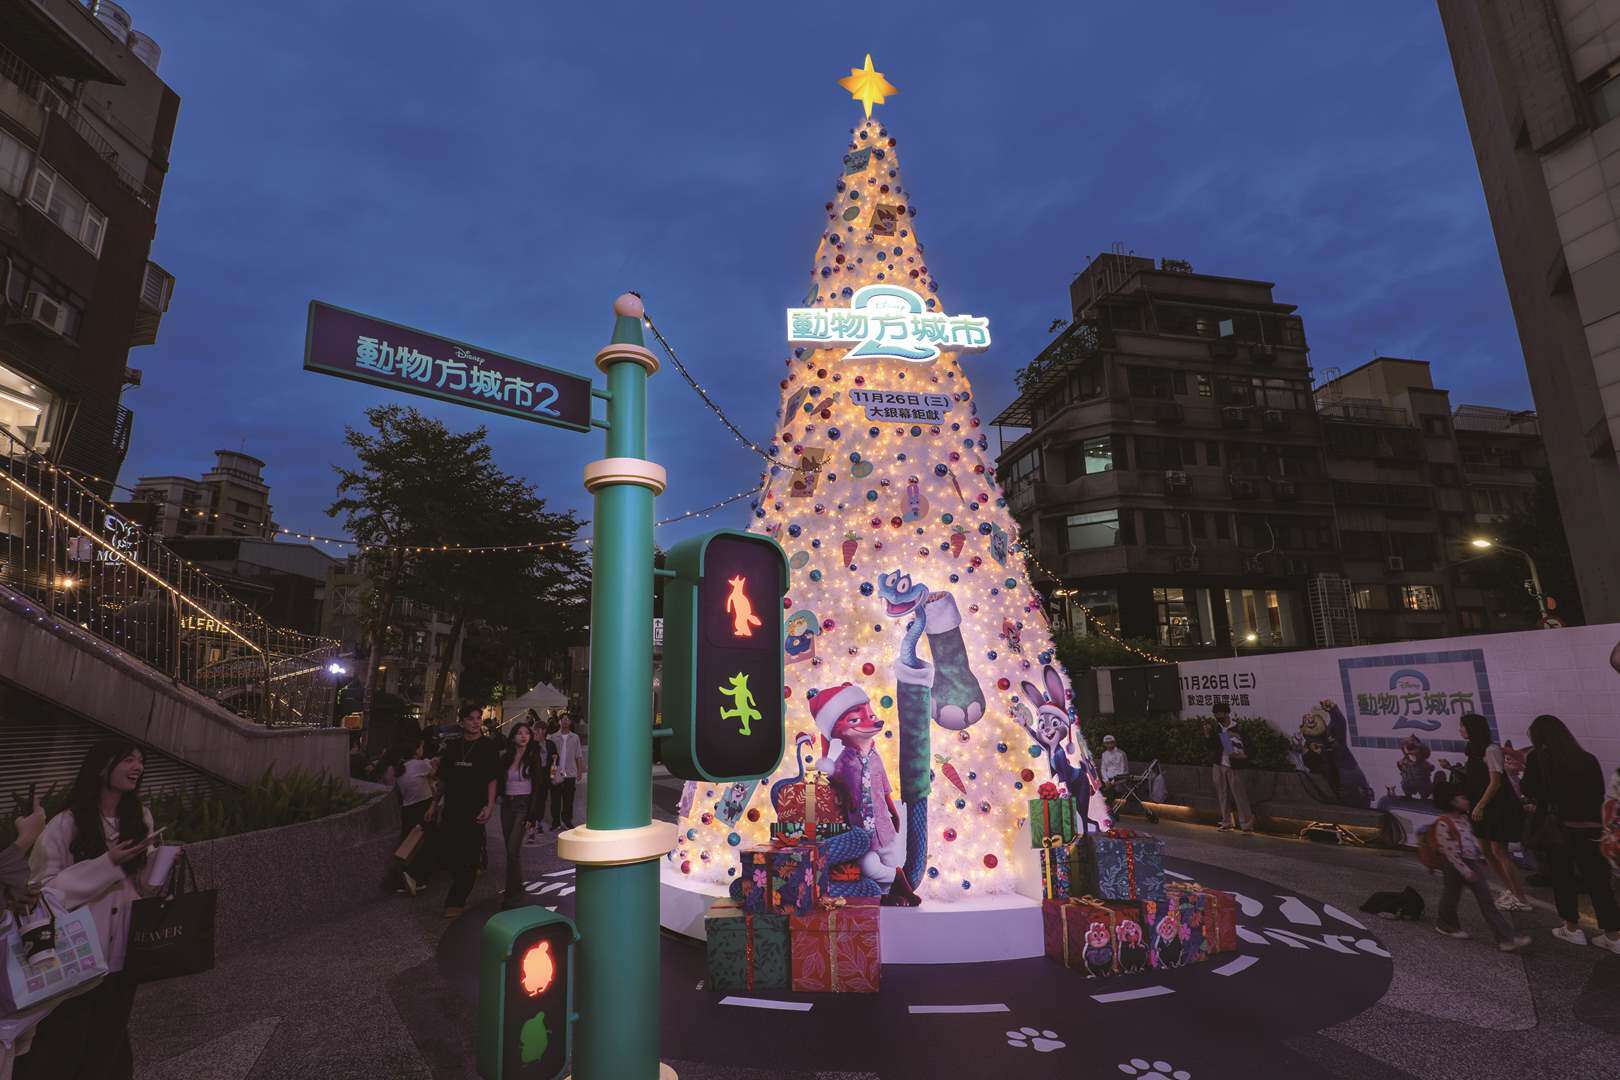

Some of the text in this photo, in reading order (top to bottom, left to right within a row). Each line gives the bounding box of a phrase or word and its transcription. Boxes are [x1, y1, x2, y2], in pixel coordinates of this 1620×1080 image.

[792, 312, 986, 346] 動物方城市
[454, 346, 486, 365] Disney
[356, 335, 561, 417] 動物方城市2
[869, 406, 940, 420] 大銀幕鉅獻
[1357, 691, 1475, 716] 動物方城市
